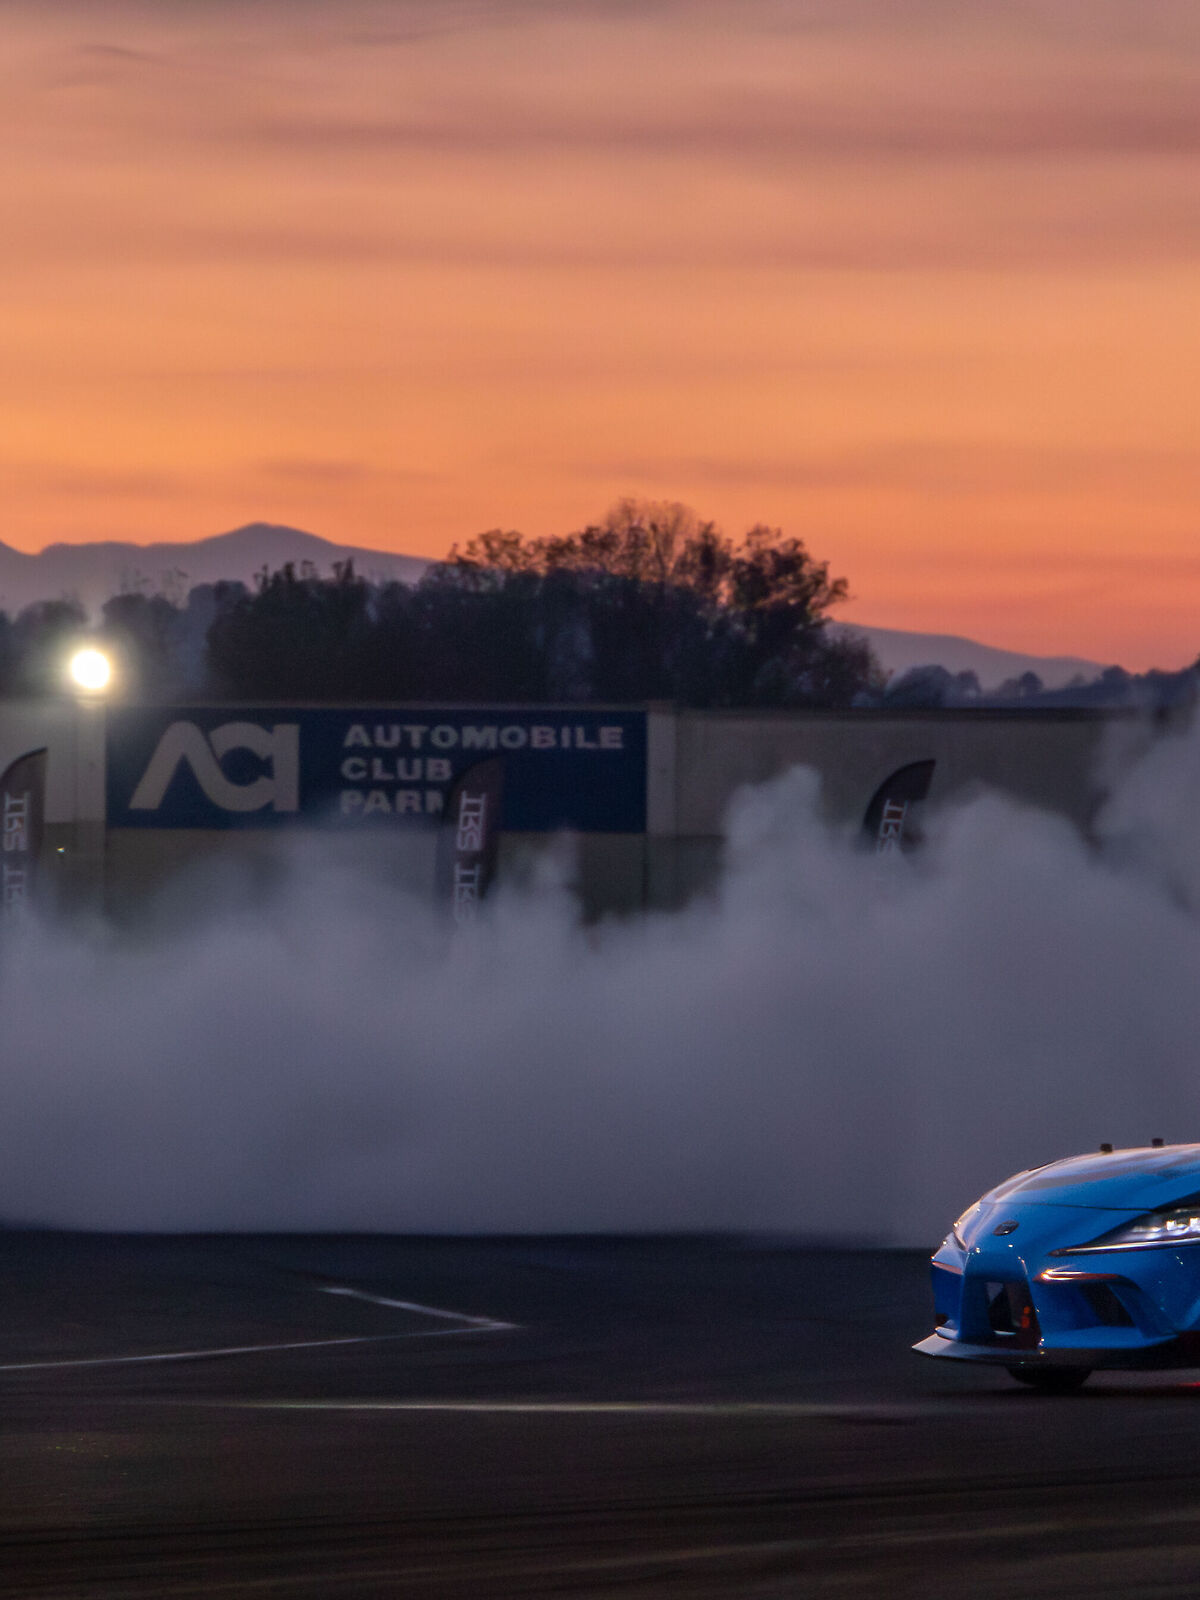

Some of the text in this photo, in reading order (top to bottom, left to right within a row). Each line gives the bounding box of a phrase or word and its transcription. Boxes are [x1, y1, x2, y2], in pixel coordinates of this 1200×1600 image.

[343, 725, 624, 749] AUTOMOBILE
[129, 721, 300, 812] ACI
[341, 757, 452, 781] CLUB
